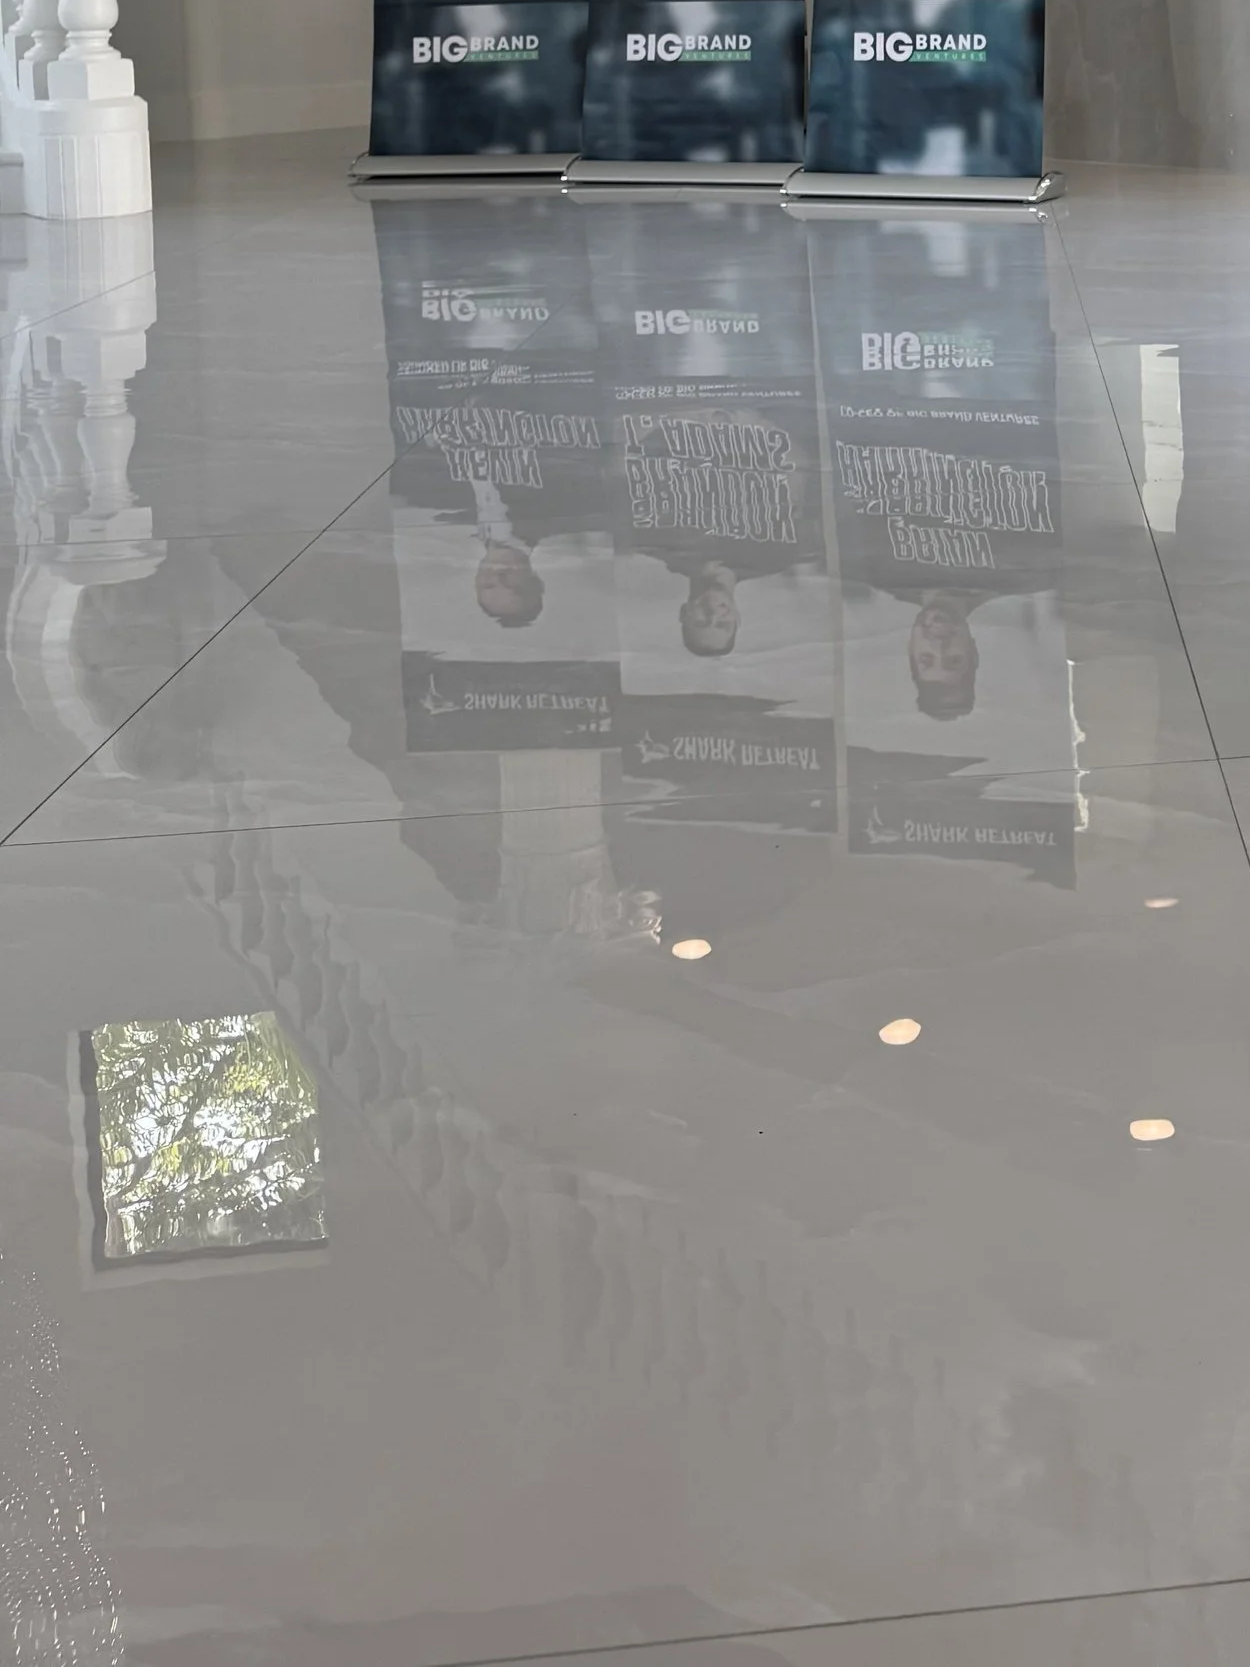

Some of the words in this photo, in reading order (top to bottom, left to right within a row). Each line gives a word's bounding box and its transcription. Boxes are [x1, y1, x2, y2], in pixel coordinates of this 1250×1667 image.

[413, 35, 468, 64] BIG
[470, 35, 539, 51] BRAND
[626, 33, 683, 62] BIG
[685, 34, 752, 50] BRAND
[854, 32, 913, 62] BIG
[915, 34, 987, 50] BRAND
[916, 52, 985, 61] VENTURES
